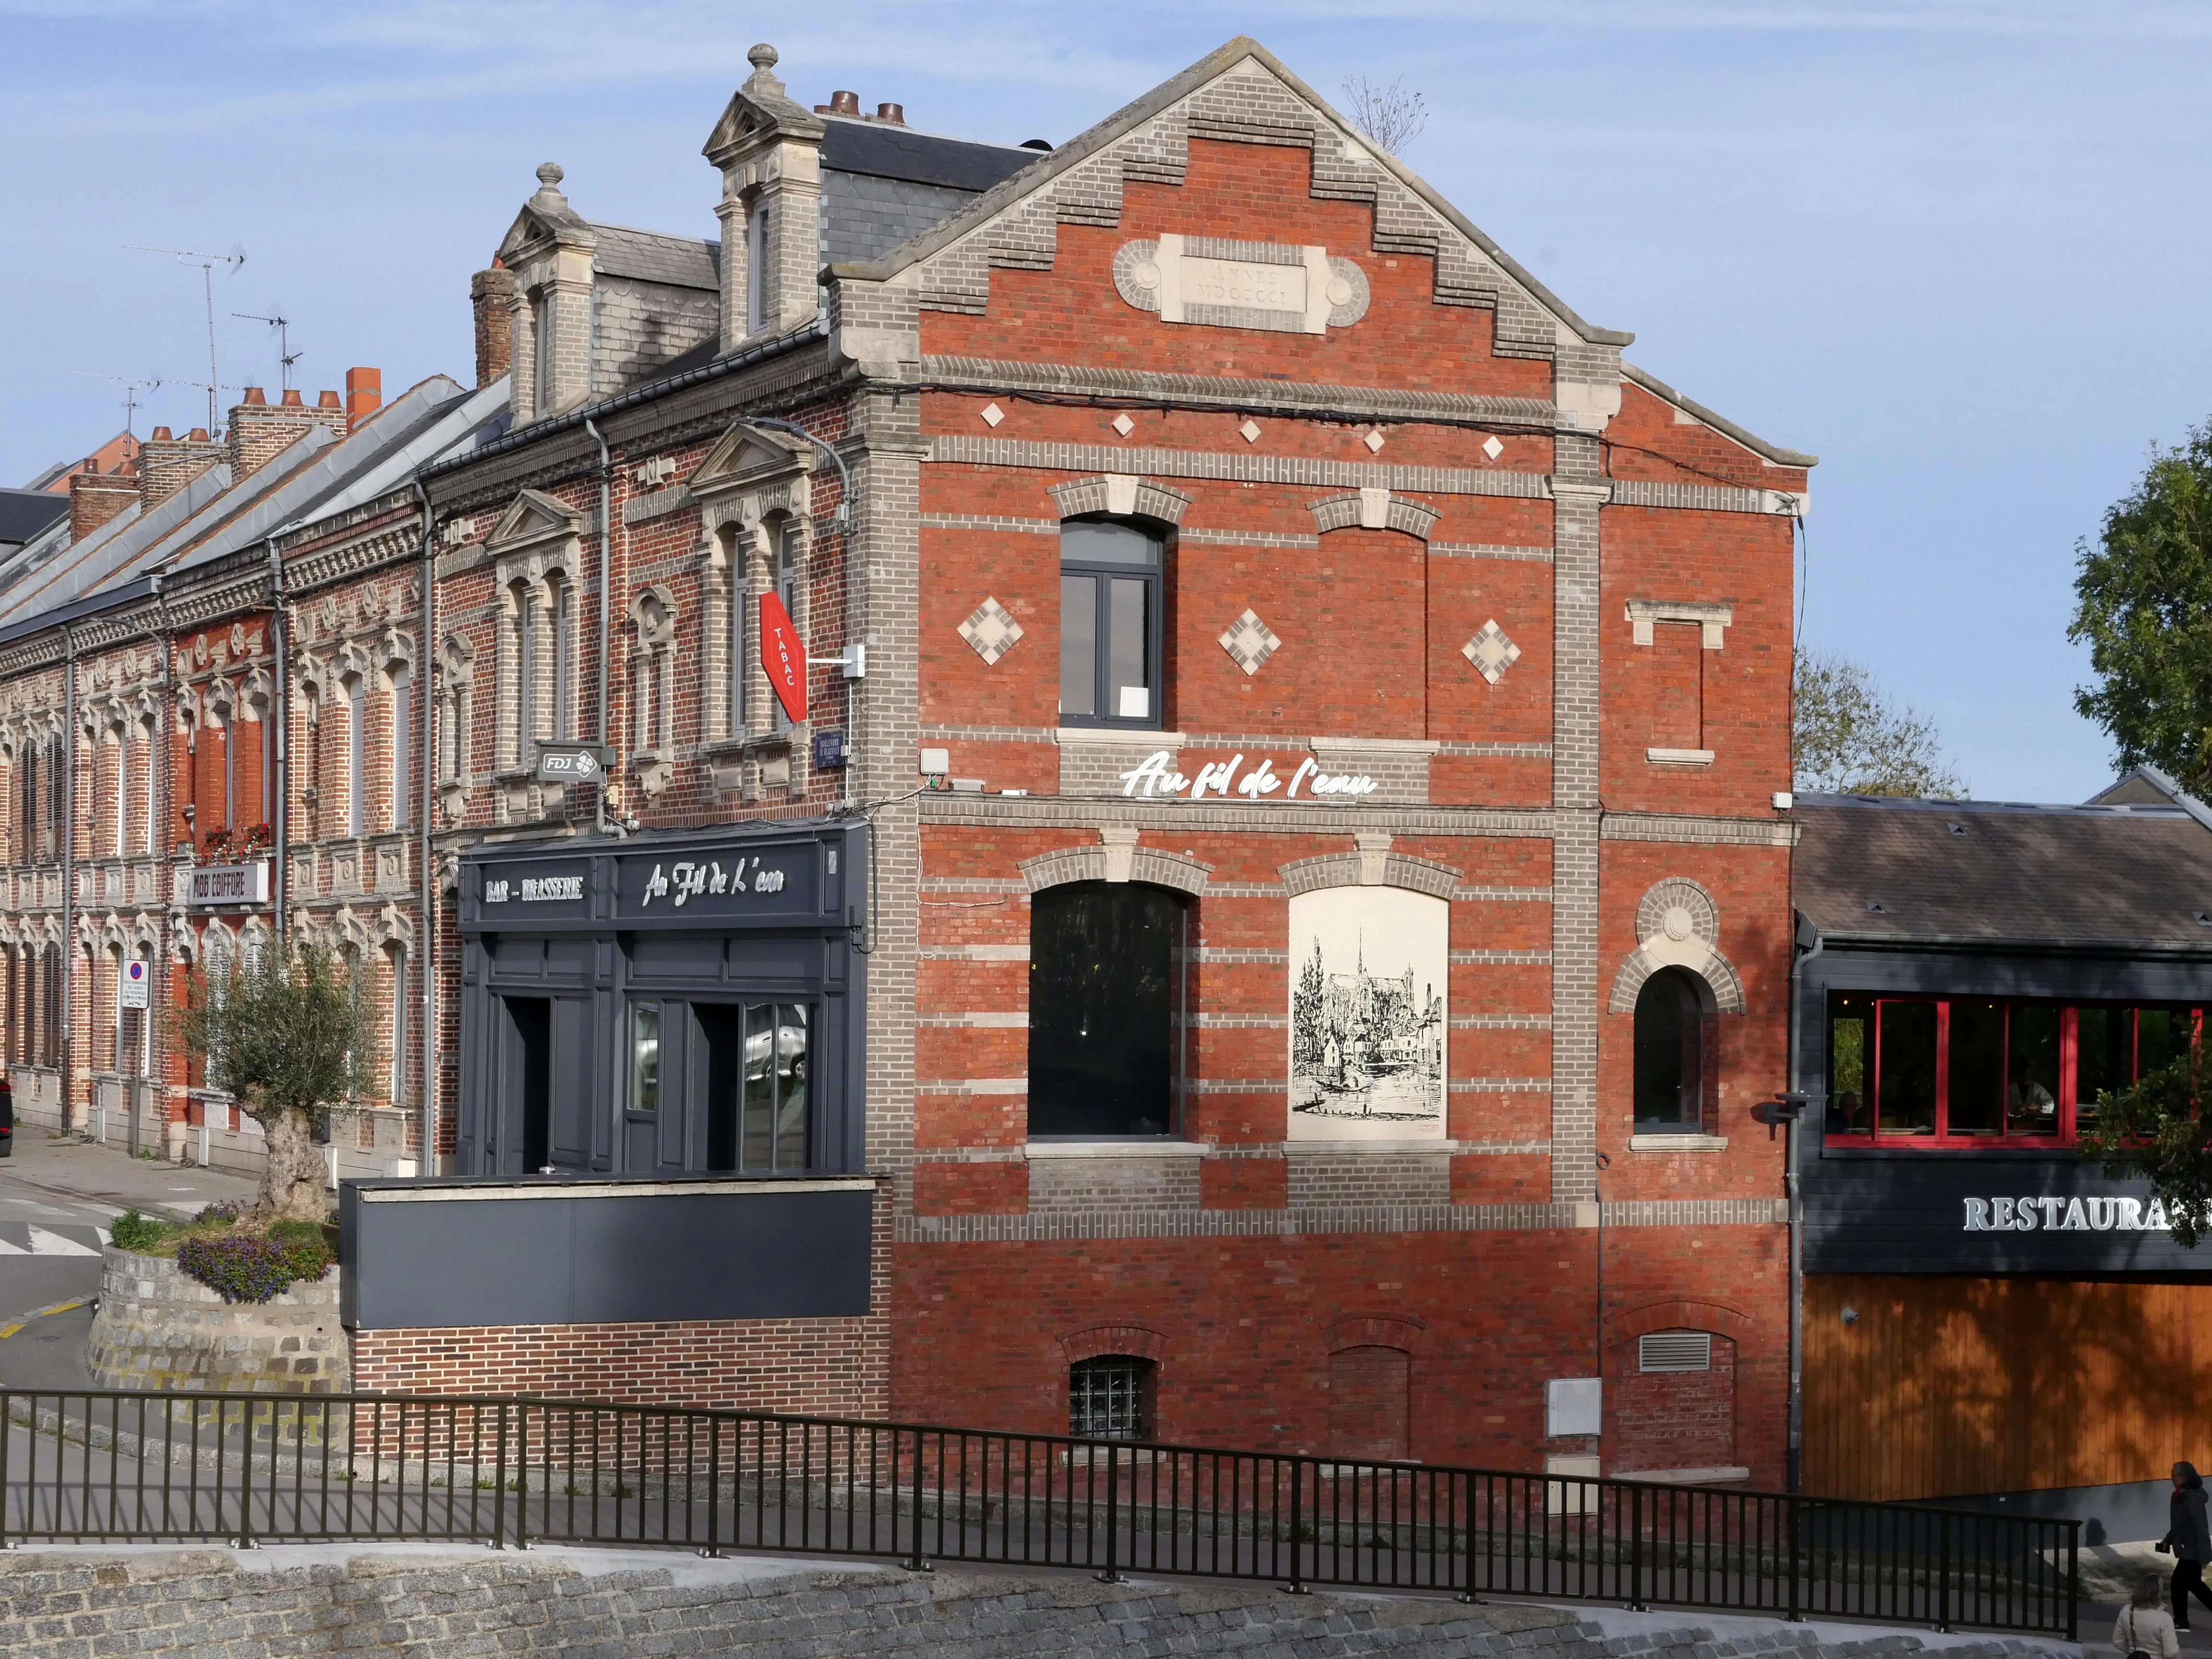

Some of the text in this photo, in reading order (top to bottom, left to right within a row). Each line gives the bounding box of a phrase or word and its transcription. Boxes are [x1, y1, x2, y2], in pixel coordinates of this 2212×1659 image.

[1198, 285, 1286, 304] MDCCCCI
[774, 627, 794, 685] TABAC
[547, 757, 572, 769] FDJ
[1119, 751, 1378, 799] Au fil de l'eau
[212, 871, 245, 898] COIFFURE
[486, 880, 509, 902] BAR
[522, 877, 583, 901] BRASSERIE
[643, 864, 667, 906] Au
[673, 863, 706, 906] Fil
[709, 862, 728, 894] de
[1964, 1197, 2212, 1231] RESTAURA
